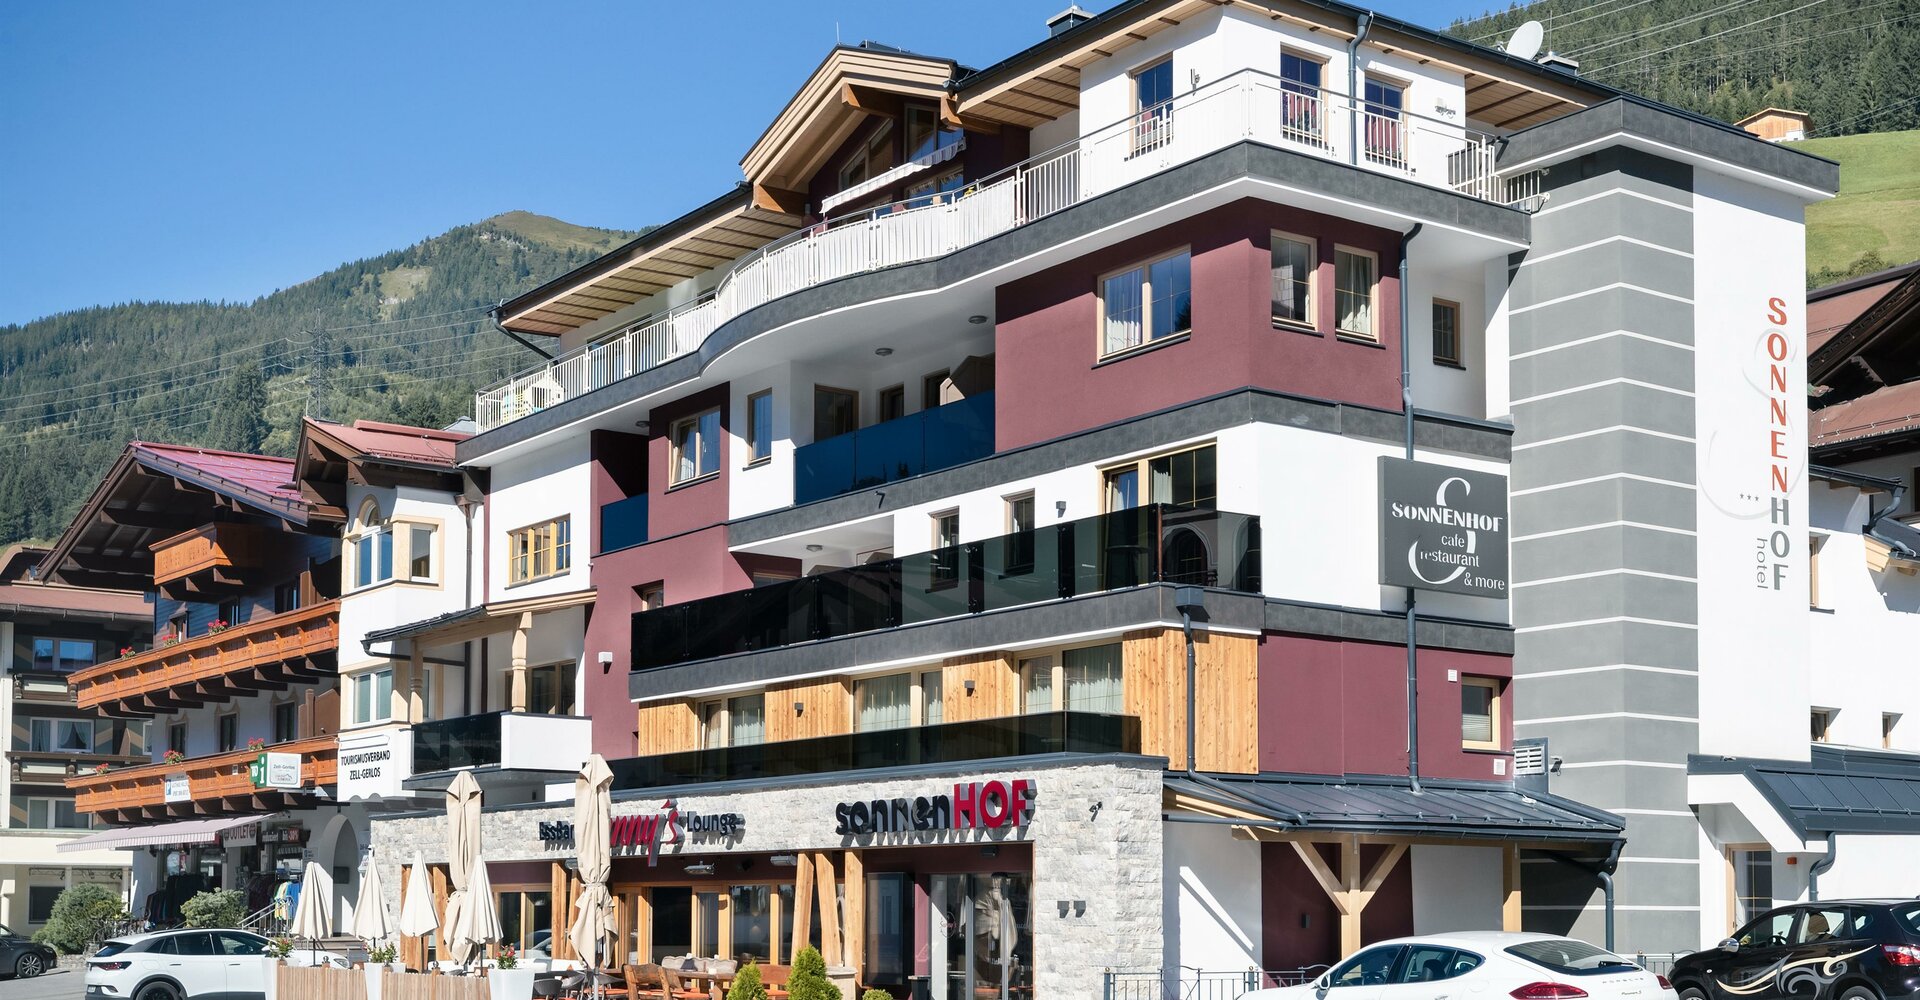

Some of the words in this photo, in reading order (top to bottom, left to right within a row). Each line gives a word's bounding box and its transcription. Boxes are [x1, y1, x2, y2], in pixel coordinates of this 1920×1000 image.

[1766, 297, 1790, 590] SONNENHOF
[1391, 501, 1504, 533] SONNENHOF
[1441, 533, 1466, 548] cafe
[1420, 549, 1480, 568] restaurant
[1756, 537, 1768, 589] hotel
[1464, 571, 1473, 587] &
[1475, 575, 1505, 591] more
[340, 749, 391, 767] TOURISMUSVERBAND
[349, 767, 381, 781] ZELL-GERLOS
[835, 779, 1032, 835] sonnenHOF
[229, 823, 250, 840] OUTLET
[539, 820, 575, 841] EssBar
[610, 798, 680, 867] nny's
[687, 810, 738, 836] Lounge
